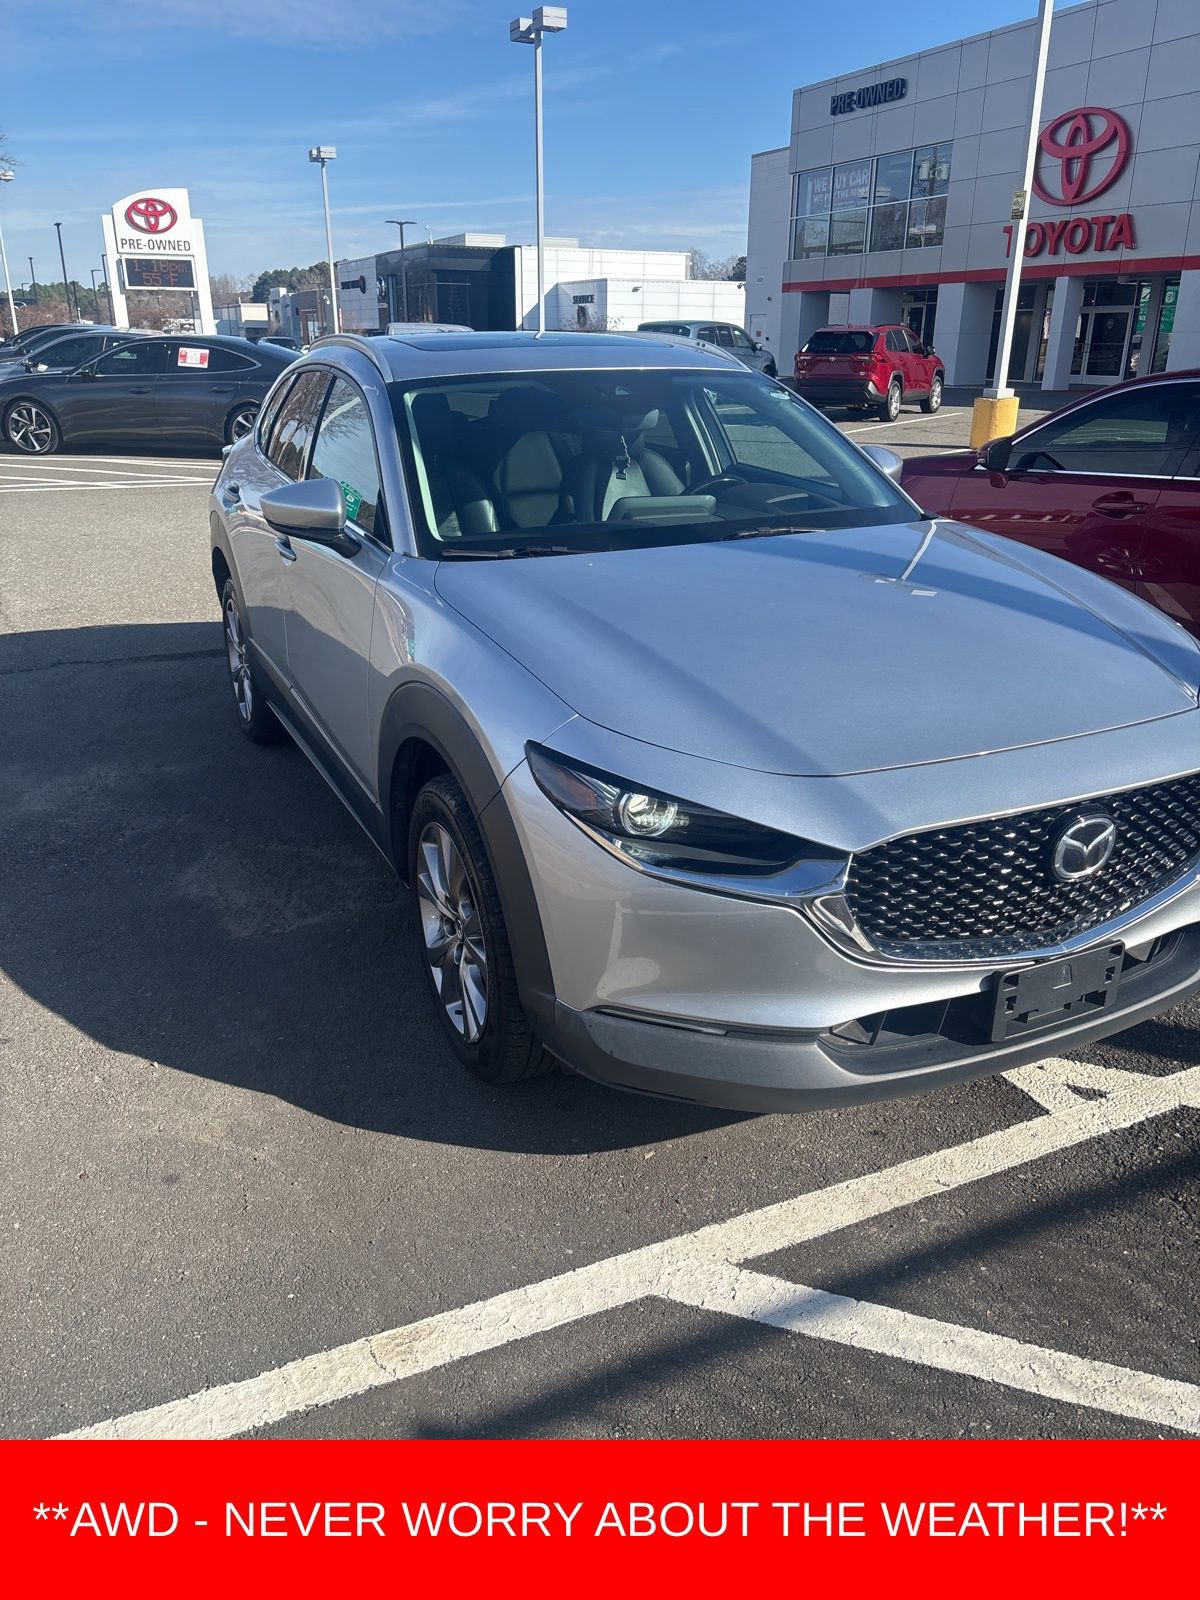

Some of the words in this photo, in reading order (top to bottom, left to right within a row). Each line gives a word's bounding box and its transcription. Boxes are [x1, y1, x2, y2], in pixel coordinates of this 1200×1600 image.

[830, 78, 907, 115] PRE-OWNED
[814, 177, 828, 193] WE
[121, 238, 191, 251] PRE-OWNED
[1003, 214, 1136, 259] TOYOTA
